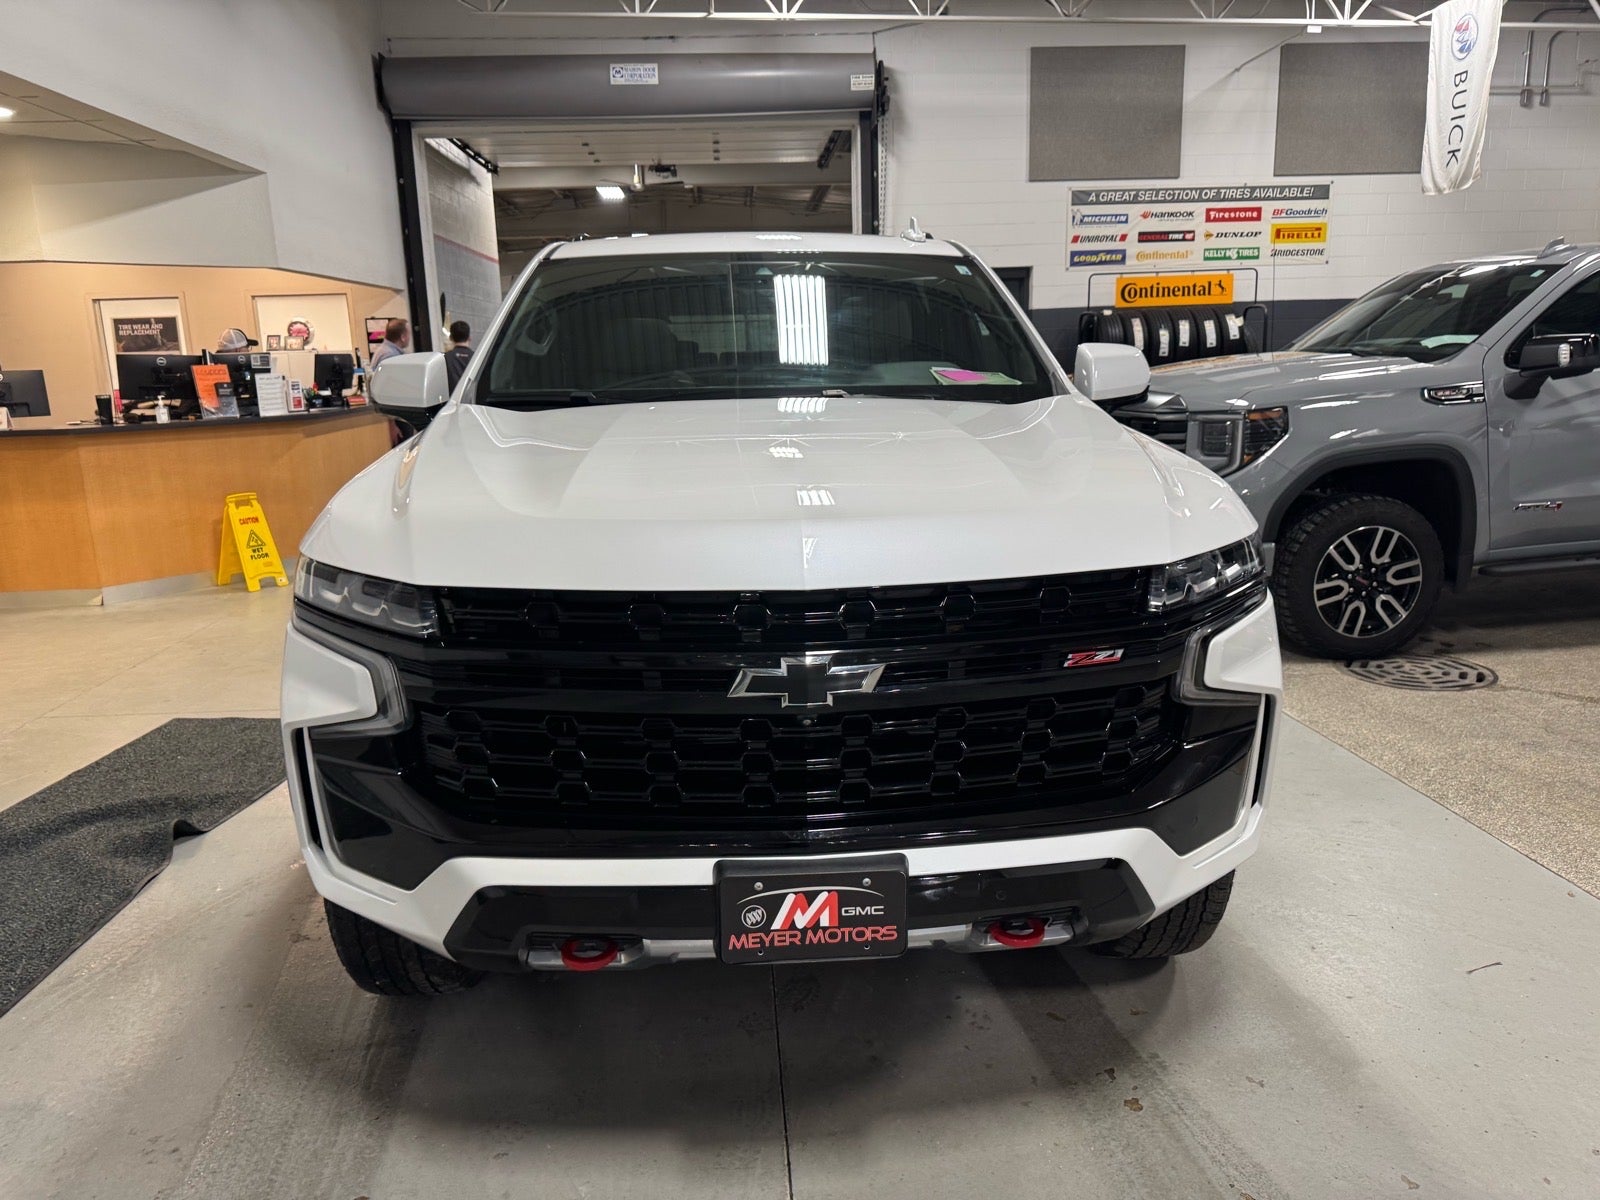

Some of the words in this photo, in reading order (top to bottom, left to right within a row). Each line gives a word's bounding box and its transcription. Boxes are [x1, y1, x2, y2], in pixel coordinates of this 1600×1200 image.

[1446, 70, 1468, 168] BUICK
[1088, 192, 1096, 202] A
[1099, 191, 1136, 202] GREAT
[1138, 189, 1200, 201] SELECTION
[1202, 189, 1218, 199] OF
[1220, 188, 1251, 199] TIRES
[1252, 187, 1314, 198] AVAILABLE!
[1209, 210, 1258, 219] Firestone
[1272, 208, 1328, 216] BFGoodrich
[1083, 215, 1127, 223] MICHELIN
[1080, 234, 1118, 243] UNIROYAL
[1215, 231, 1262, 239] DUNLOP
[1275, 227, 1322, 240] PIRELLI
[1074, 252, 1122, 263] GOODYEAR
[1136, 250, 1189, 261] Continental
[1204, 248, 1226, 257] KELLY
[1239, 248, 1259, 257] TIRES
[1270, 248, 1325, 257] BRIDGESTONE
[1120, 281, 1212, 304] Continental
[240, 517, 259, 525] CAUTION
[841, 905, 885, 916] GMC
[728, 929, 801, 950] MEYER
[805, 925, 898, 945] MOTORS
